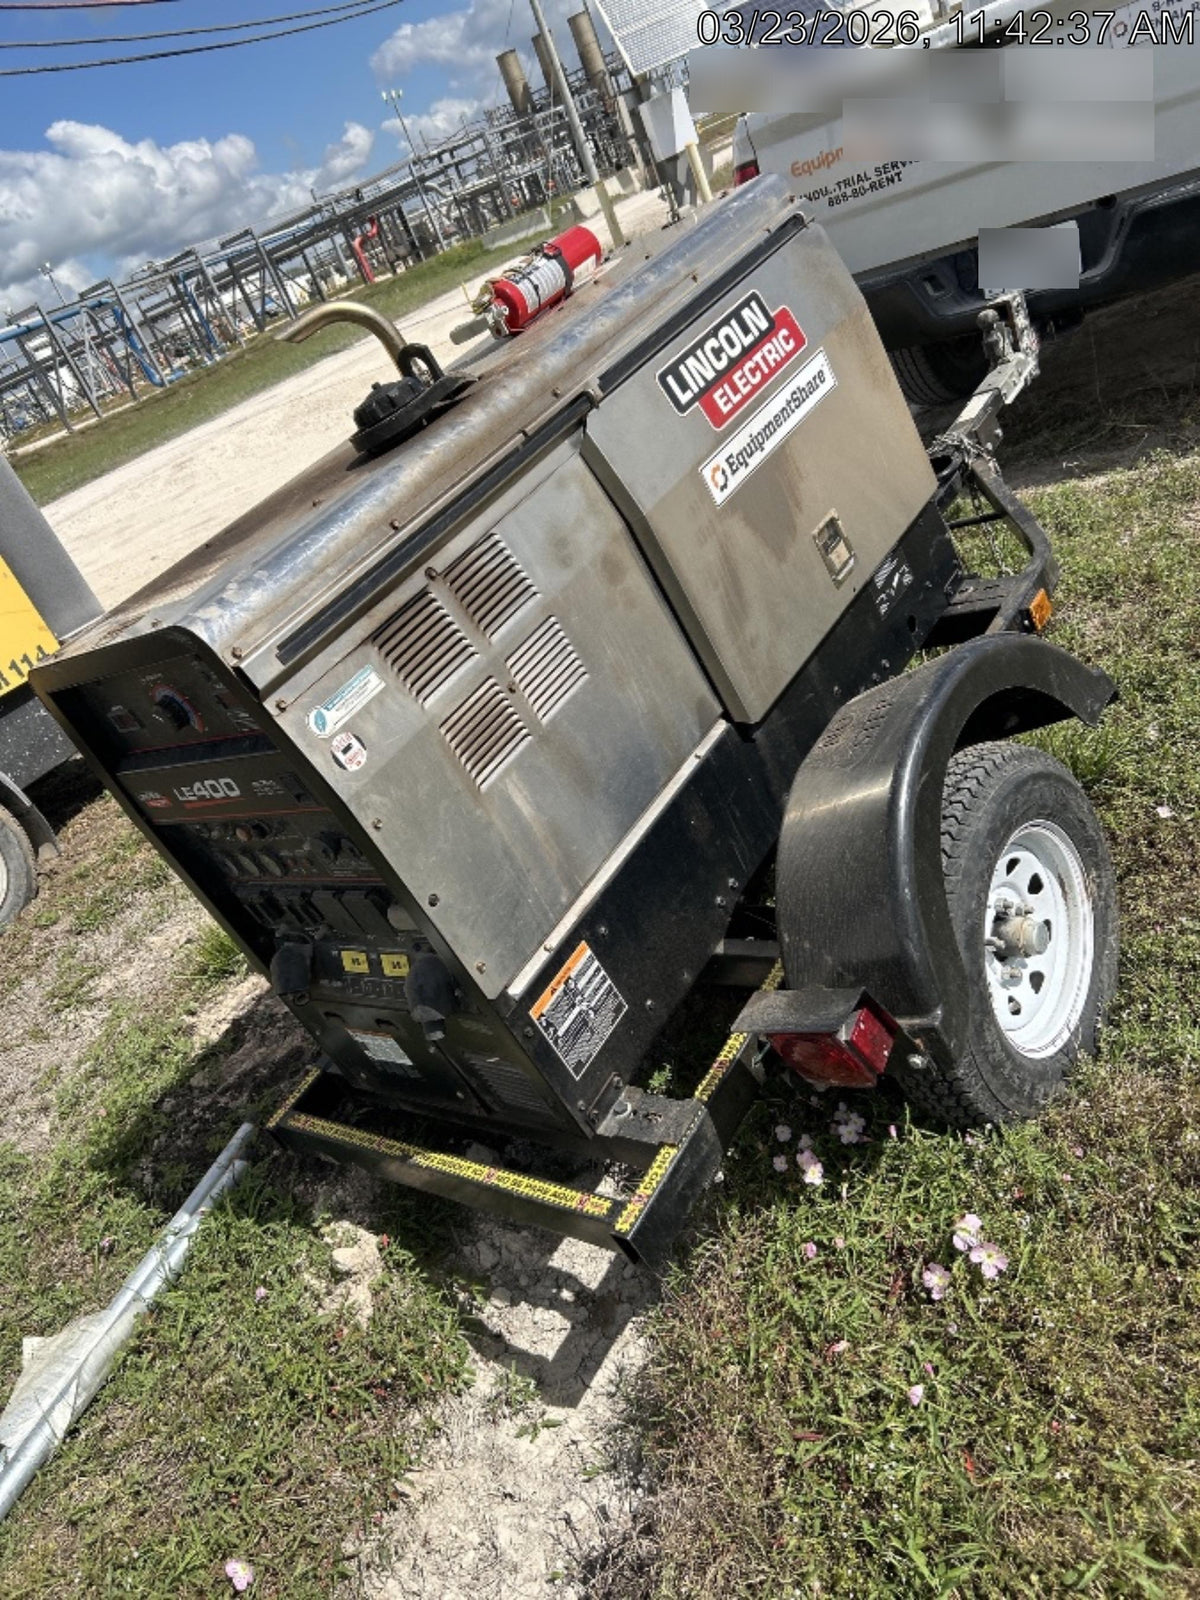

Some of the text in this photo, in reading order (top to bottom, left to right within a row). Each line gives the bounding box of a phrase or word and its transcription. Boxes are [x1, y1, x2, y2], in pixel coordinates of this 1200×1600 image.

[666, 300, 770, 405] LINCOLN
[713, 328, 796, 415] ELECTRIC
[725, 369, 826, 474] EquipmentShare
